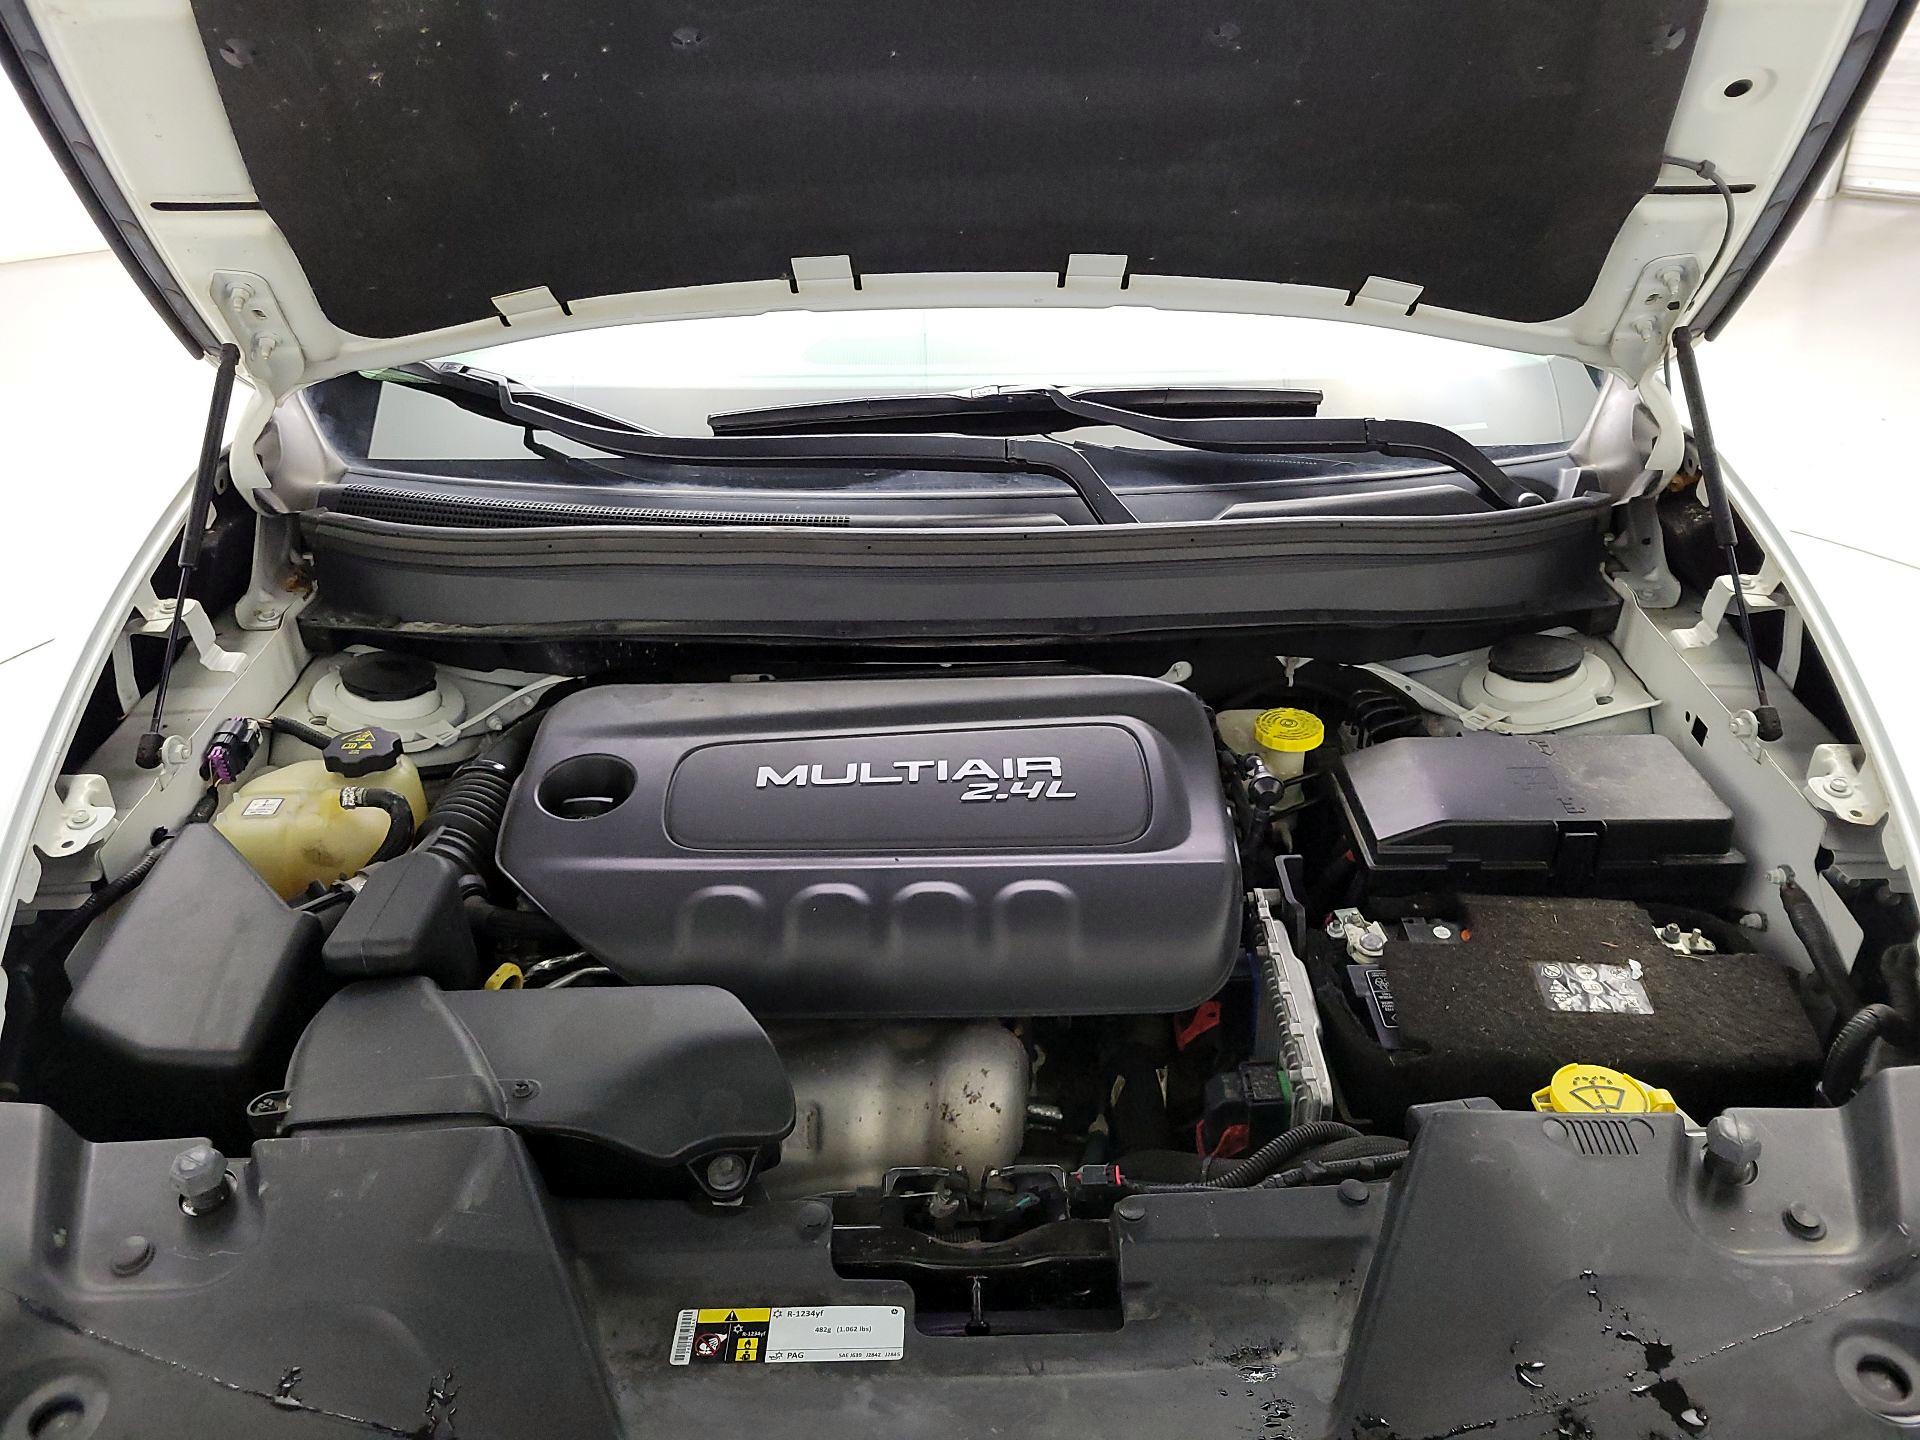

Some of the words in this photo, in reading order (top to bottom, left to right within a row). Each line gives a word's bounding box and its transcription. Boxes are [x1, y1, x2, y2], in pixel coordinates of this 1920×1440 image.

[755, 756, 1062, 788] MULTIAIR
[960, 780, 1077, 802] 2.4L
[787, 1309, 824, 1319] R-1234yf
[859, 1325, 872, 1333] lbs)
[787, 1351, 804, 1359] PAG
